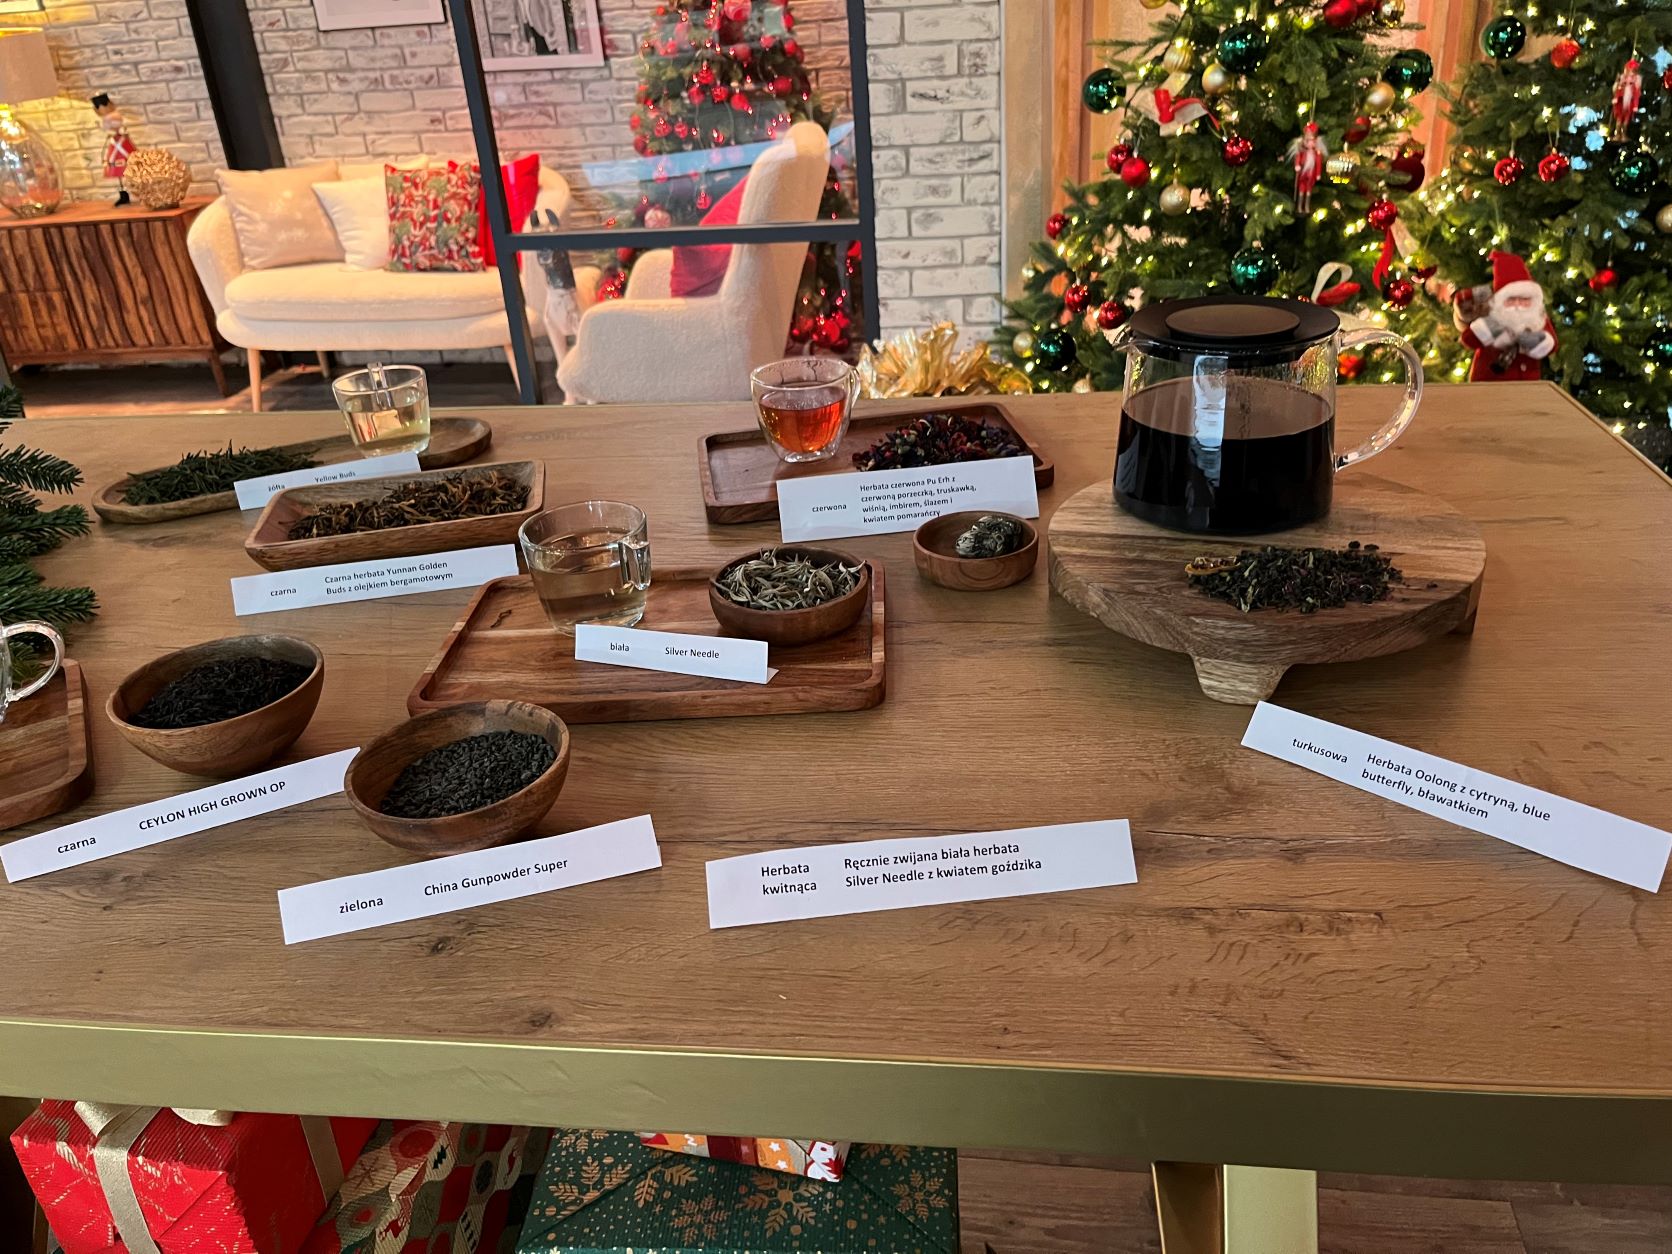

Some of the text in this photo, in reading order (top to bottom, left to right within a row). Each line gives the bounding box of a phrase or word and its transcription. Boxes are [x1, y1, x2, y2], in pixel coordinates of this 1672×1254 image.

[315, 475, 338, 483] Yellow
[860, 484, 889, 492] Herbata
[890, 479, 925, 489] czerwona
[861, 485, 977, 502] czerwoną porzeczką, truskawką,
[812, 503, 847, 513] czerwona
[863, 503, 887, 513] wiśnią,
[889, 500, 922, 510] imbirem,
[923, 498, 949, 507] ślazem
[863, 510, 941, 523] kwiatem pomarańczy
[325, 561, 448, 584] Czarna herbata Yunnan Golden
[270, 587, 297, 597] czarna
[326, 585, 346, 595] Buds
[354, 580, 388, 592] olejkiem
[390, 572, 453, 587] bergamotowym
[610, 643, 629, 651] biała
[665, 647, 720, 658] Silver Needle
[1292, 738, 1348, 764] turkusowa
[1361, 768, 1488, 818] butterfly, bławatkiem
[1367, 753, 1412, 776] Herbata
[1415, 769, 1457, 792] Oolong
[1469, 787, 1518, 812] cytryną,
[1522, 802, 1551, 821] blue
[139, 781, 286, 830] CEYLON HIGH GROWN OP
[57, 836, 96, 854] czarna
[844, 843, 1019, 870] Ręcznie zwijana biała herbata
[424, 859, 568, 896] China Gunpowder Super
[761, 864, 810, 877] Herbata
[845, 874, 879, 887] Silver
[882, 870, 925, 884] Needle
[936, 864, 988, 879] kwiatem
[991, 860, 1042, 875] goździka
[762, 881, 817, 896] kwitnąca
[339, 897, 383, 914] zielona
